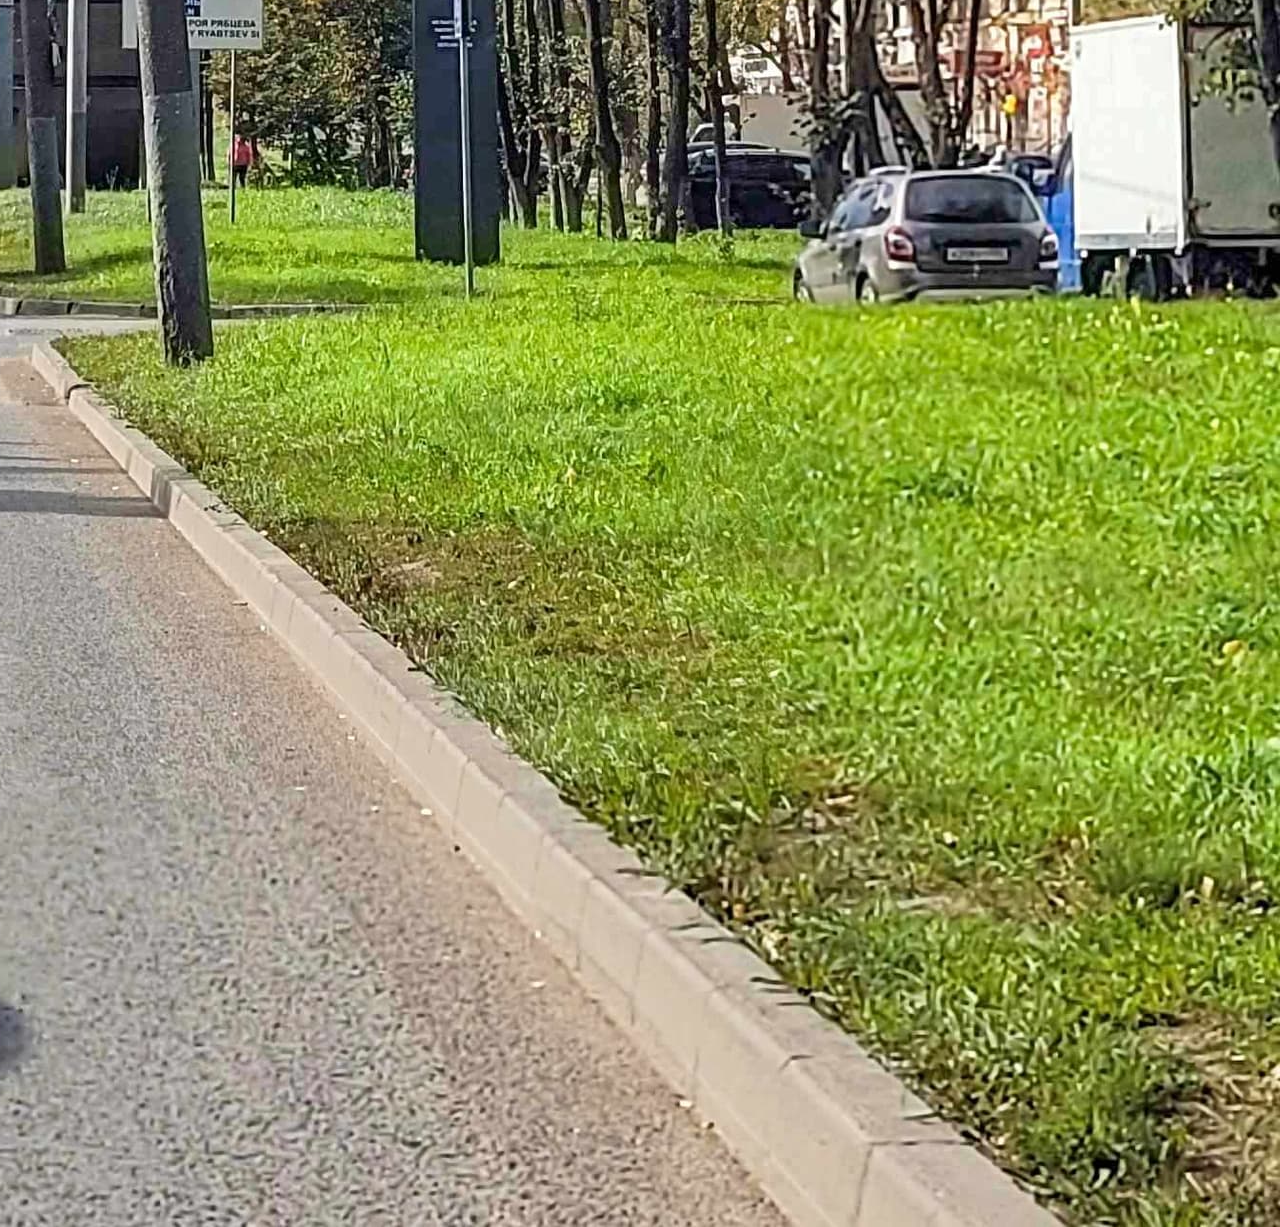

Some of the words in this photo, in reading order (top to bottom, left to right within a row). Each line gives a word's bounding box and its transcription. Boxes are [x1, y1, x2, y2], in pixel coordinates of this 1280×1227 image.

[189, 19, 208, 28] РОЯ
[211, 20, 256, 29] РЯБЦЕВА
[198, 30, 248, 38] RYABTSEV
